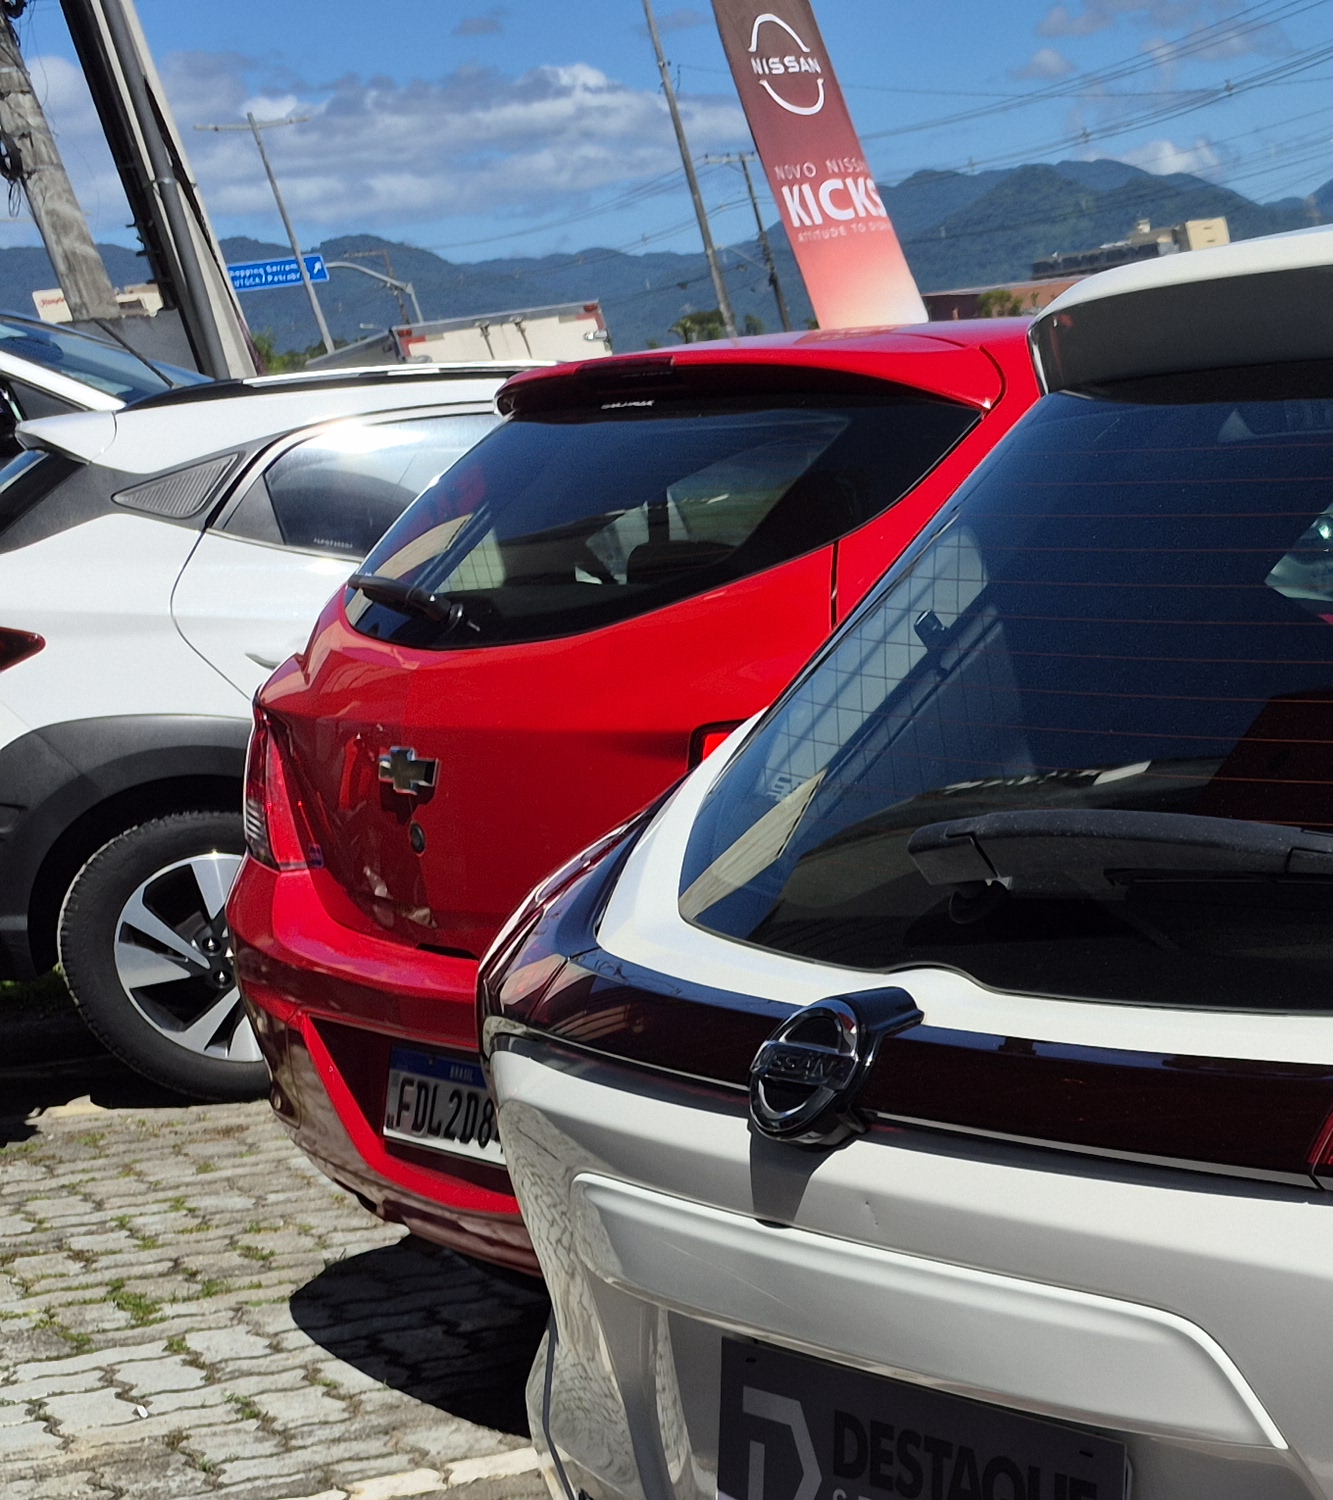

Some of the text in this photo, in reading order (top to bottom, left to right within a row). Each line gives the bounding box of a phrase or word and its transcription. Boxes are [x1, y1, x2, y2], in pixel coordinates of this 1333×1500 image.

[751, 56, 822, 75] NISSAN
[774, 161, 817, 181] NOVO
[781, 177, 887, 228] KICKS
[395, 1076, 502, 1150] FDL2D8
